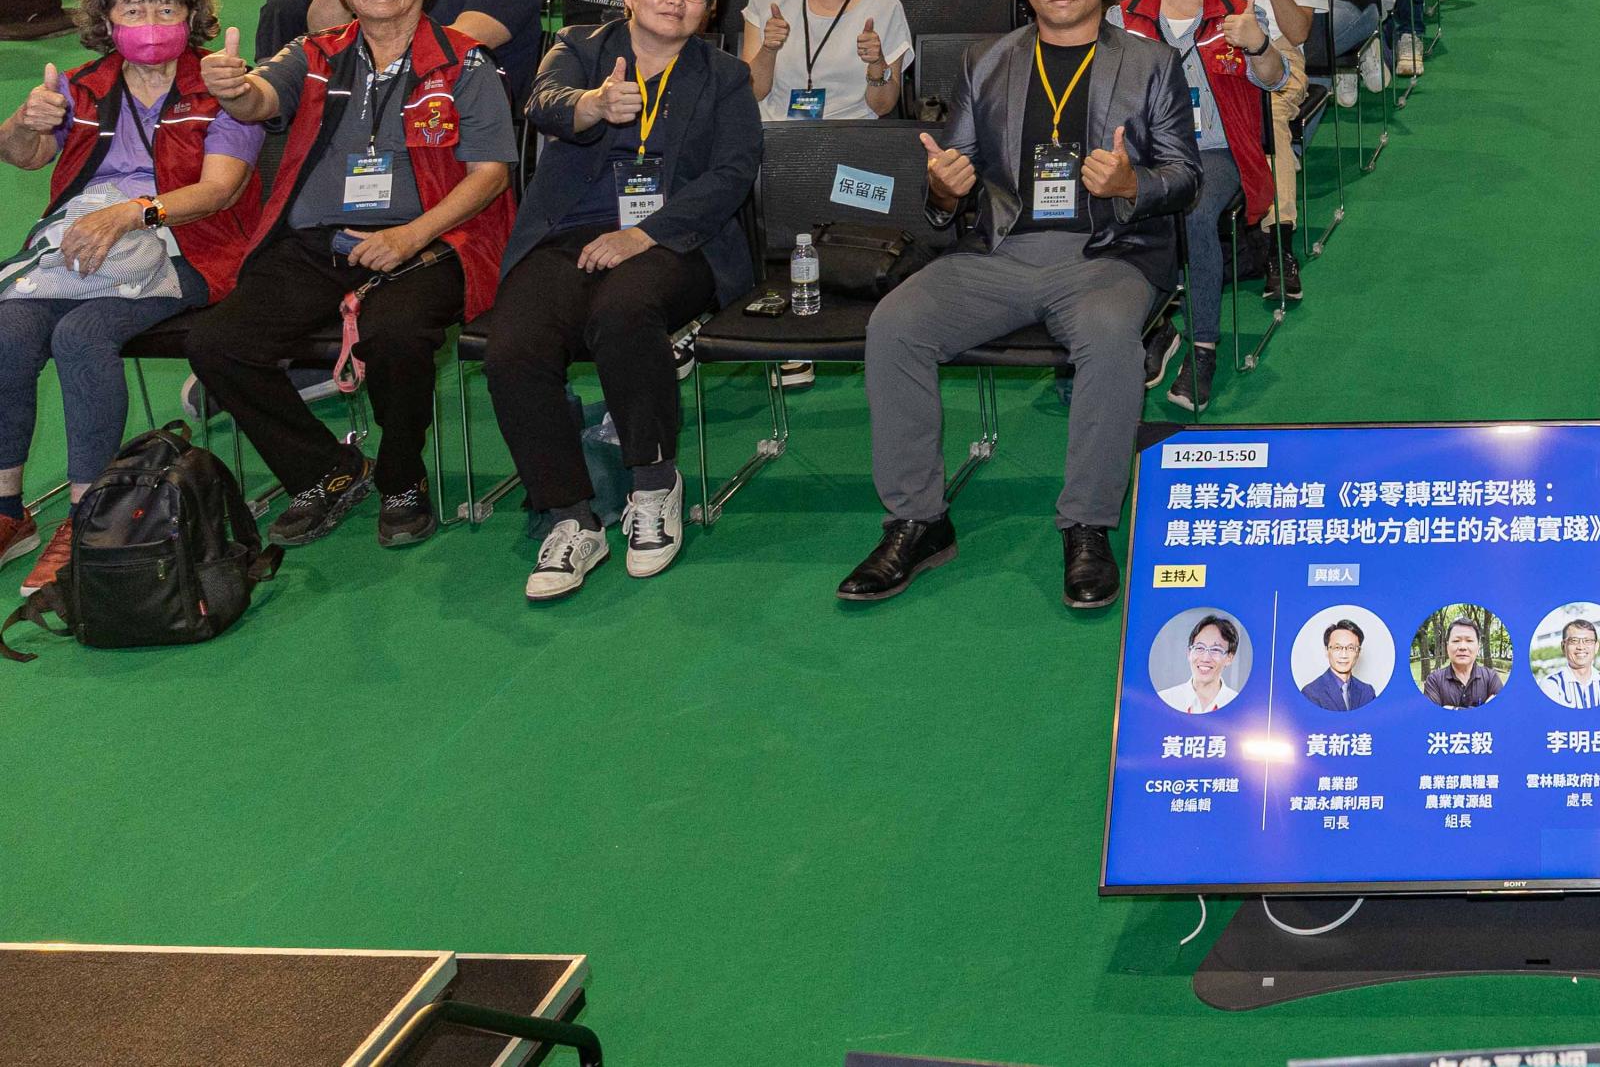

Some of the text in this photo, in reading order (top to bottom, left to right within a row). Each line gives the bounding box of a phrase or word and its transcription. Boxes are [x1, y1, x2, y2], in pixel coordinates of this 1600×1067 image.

[839, 177, 888, 202] 保留席
[1173, 449, 1257, 463] 14:20-15:50
[1161, 570, 1199, 583] 主持人
[1161, 735, 1227, 759] 黃昭勇
[1306, 733, 1373, 757] 黃新達
[1427, 731, 1493, 755] 洪宏毅
[1145, 778, 1239, 793] CSR@天下頻道
[1318, 776, 1358, 791] 農業部
[1170, 798, 1211, 812] 總編輯
[1290, 795, 1384, 811] 資源永續利用司
[1425, 794, 1492, 809] 農業資源組
[1566, 792, 1593, 807] 處長
[1323, 816, 1350, 830] 司長
[1444, 813, 1472, 828] 組長
